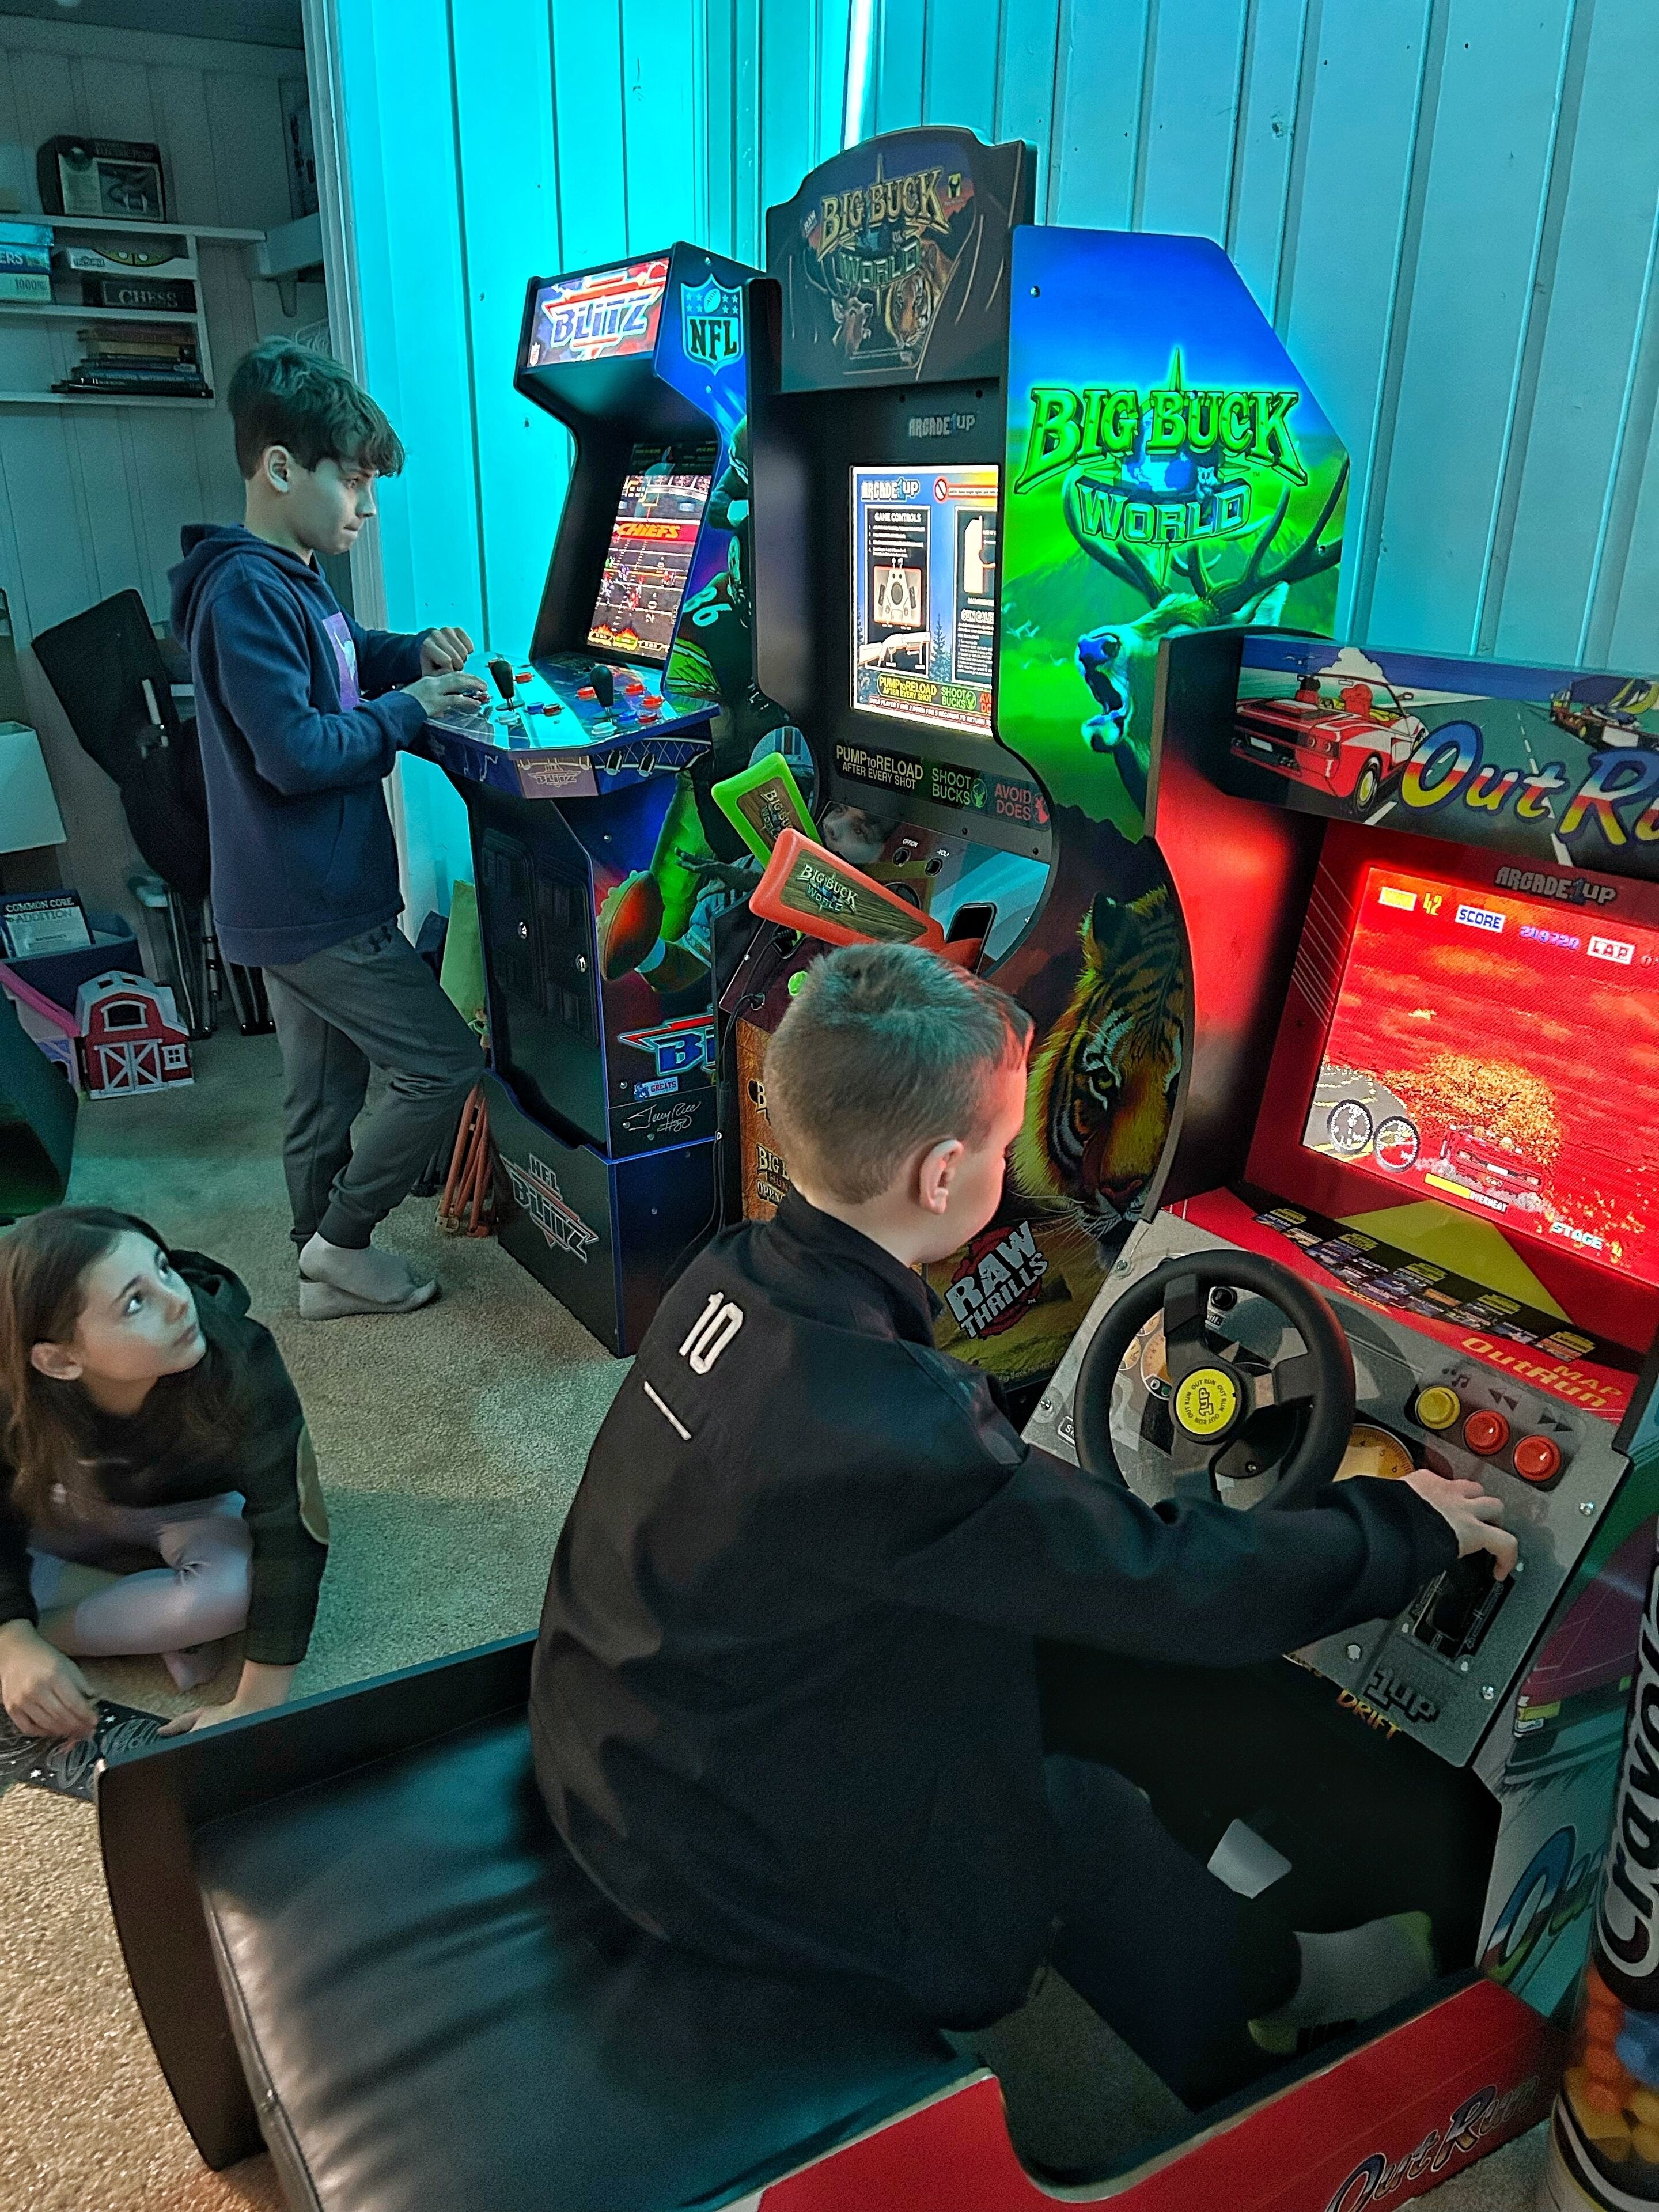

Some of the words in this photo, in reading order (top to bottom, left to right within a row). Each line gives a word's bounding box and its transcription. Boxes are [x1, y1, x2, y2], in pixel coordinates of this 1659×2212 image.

[817, 190, 864, 262] BIG
[868, 167, 949, 234] BUCK
[839, 237, 921, 287] WORLD
[118, 289, 178, 308] CHESS
[554, 293, 650, 344] BLITZ
[689, 318, 737, 361] NFL
[1014, 388, 1139, 494] BIG
[1146, 389, 1308, 487] BUCK
[1075, 479, 1252, 544] WORLD
[618, 522, 681, 539] CHIEFS
[879, 676, 900, 690] PUMP
[905, 681, 937, 696] RELOAD
[883, 687, 900, 696] AFTER
[917, 694, 932, 702] SHOT
[941, 686, 966, 698] SHOOT
[941, 696, 967, 710] BUCKS
[836, 745, 868, 764] PUMP
[876, 756, 923, 781] RELOAD
[842, 763, 866, 777] AFTER
[868, 768, 893, 783] EVERY
[895, 775, 916, 790] SHOT
[931, 768, 971, 790] SHOOT
[760, 789, 783, 811] BIG
[932, 783, 971, 805] BUCKS
[994, 783, 1032, 804] AVOID
[997, 800, 1032, 821] DOES
[797, 864, 825, 889] BIG
[824, 876, 859, 914] BUCK
[806, 884, 844, 912] WORLD
[6, 900, 49, 912] COMMON
[1459, 908, 1502, 929] SCORE
[1593, 940, 1629, 961] LAP
[650, 1081, 677, 1093] GREATS
[757, 1145, 779, 1175] BIG
[1550, 1221, 1605, 1251] STAGE
[945, 1220, 1036, 1322] RAW
[961, 1252, 1048, 1338] THRILLS
[678, 1291, 744, 1375] 10
[1191, 1380, 1203, 1390] OUT
[1553, 1365, 1623, 1396] MAP
[1336, 1688, 1403, 1740] DRIFT
